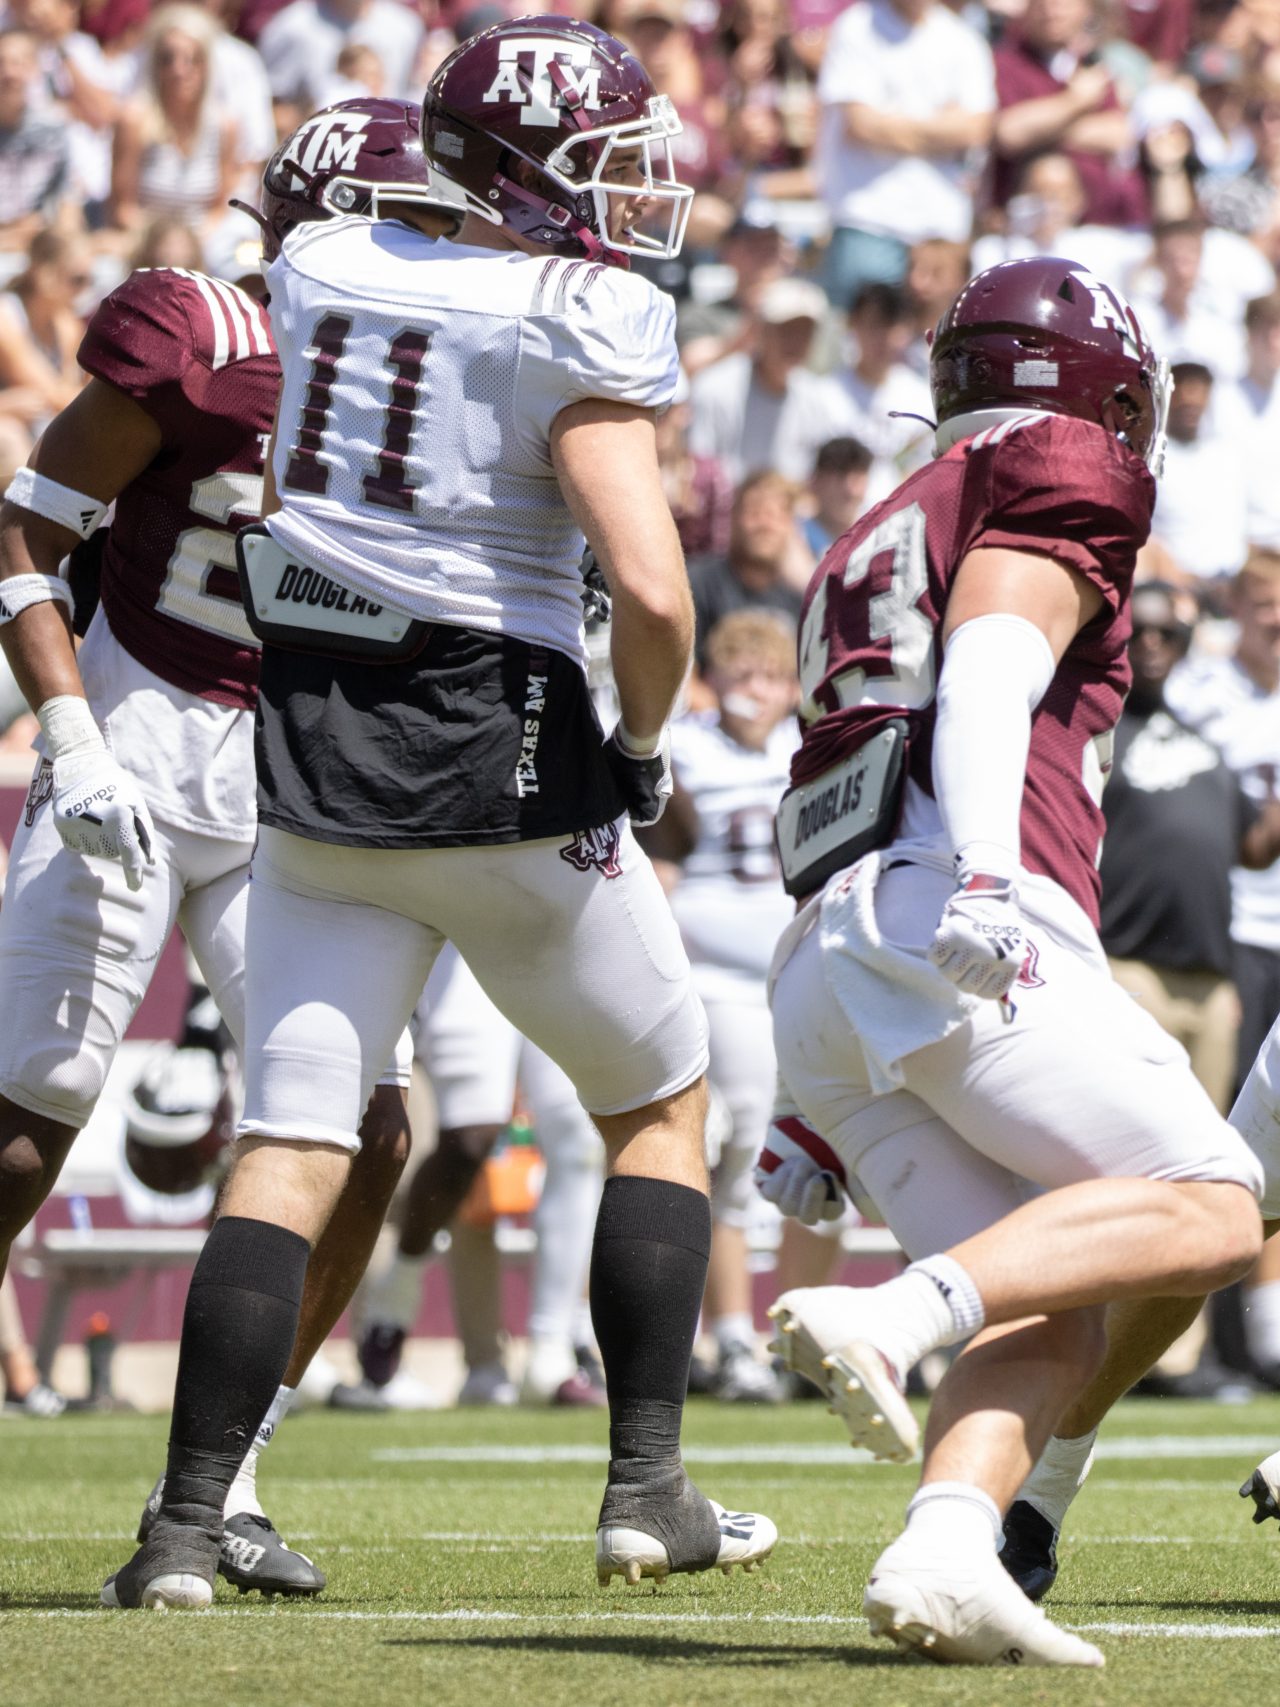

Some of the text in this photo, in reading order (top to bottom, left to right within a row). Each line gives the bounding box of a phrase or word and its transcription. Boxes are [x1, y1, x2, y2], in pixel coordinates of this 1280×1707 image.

[284, 311, 434, 515] 11
[516, 719, 540, 798] TEXAS
[65, 784, 117, 818] adidas
[794, 768, 865, 851] DOUGLAS
[972, 922, 1021, 937] adidas
